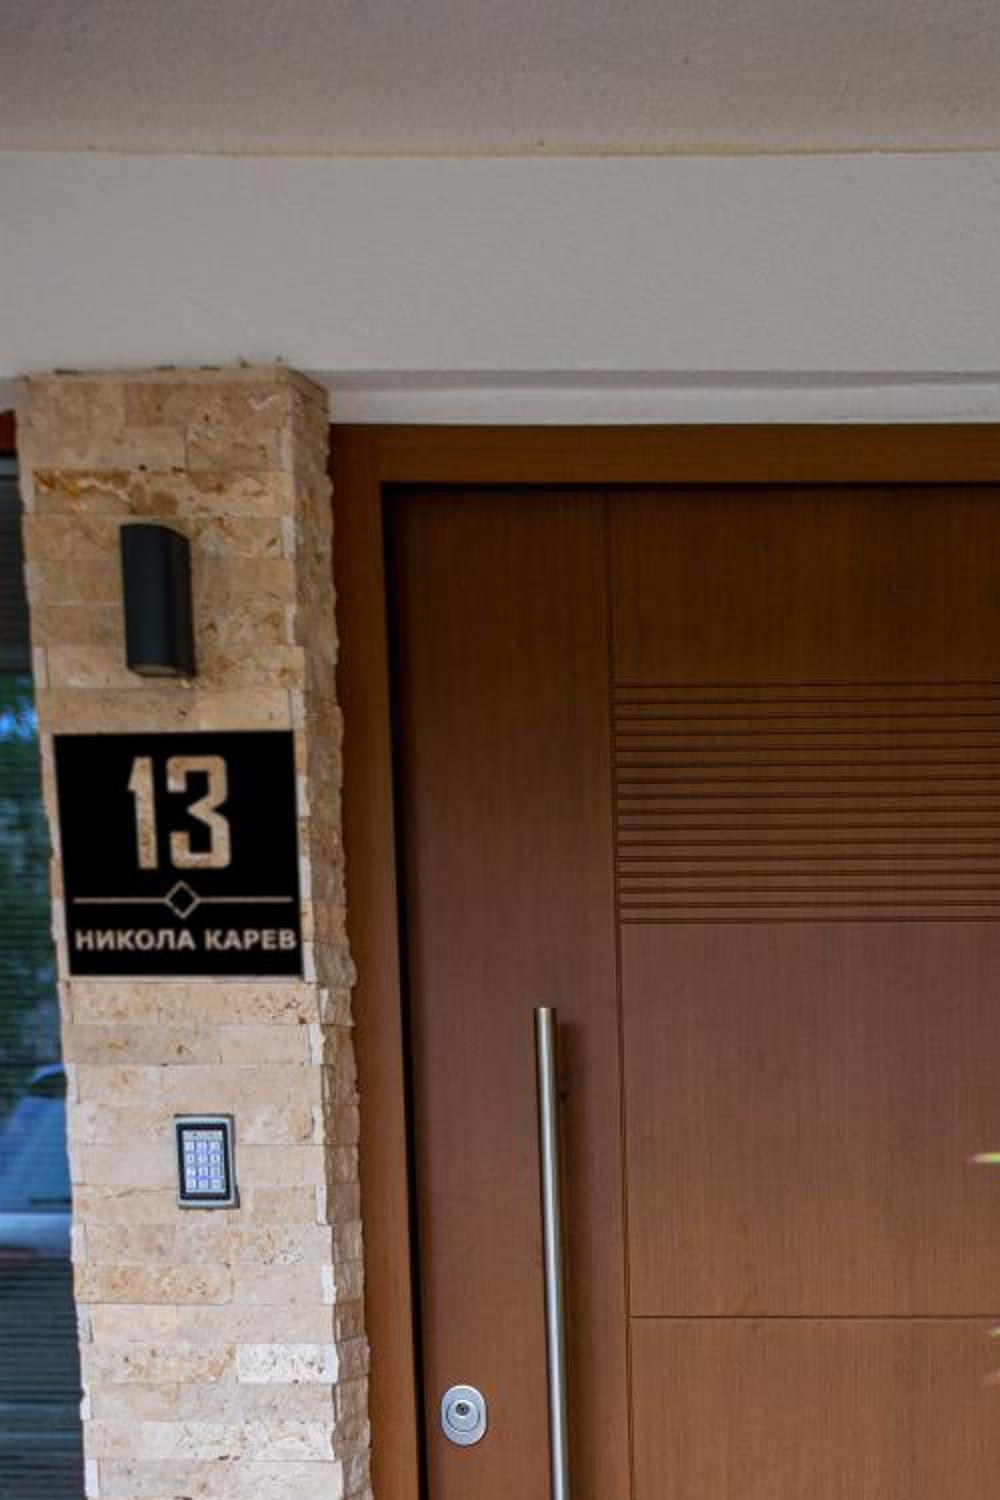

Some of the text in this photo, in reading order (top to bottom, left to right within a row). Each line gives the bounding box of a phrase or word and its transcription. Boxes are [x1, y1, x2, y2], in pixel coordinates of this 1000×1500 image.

[128, 755, 231, 869] 13
[75, 928, 297, 950] НИКОЛА КАРЕВ
